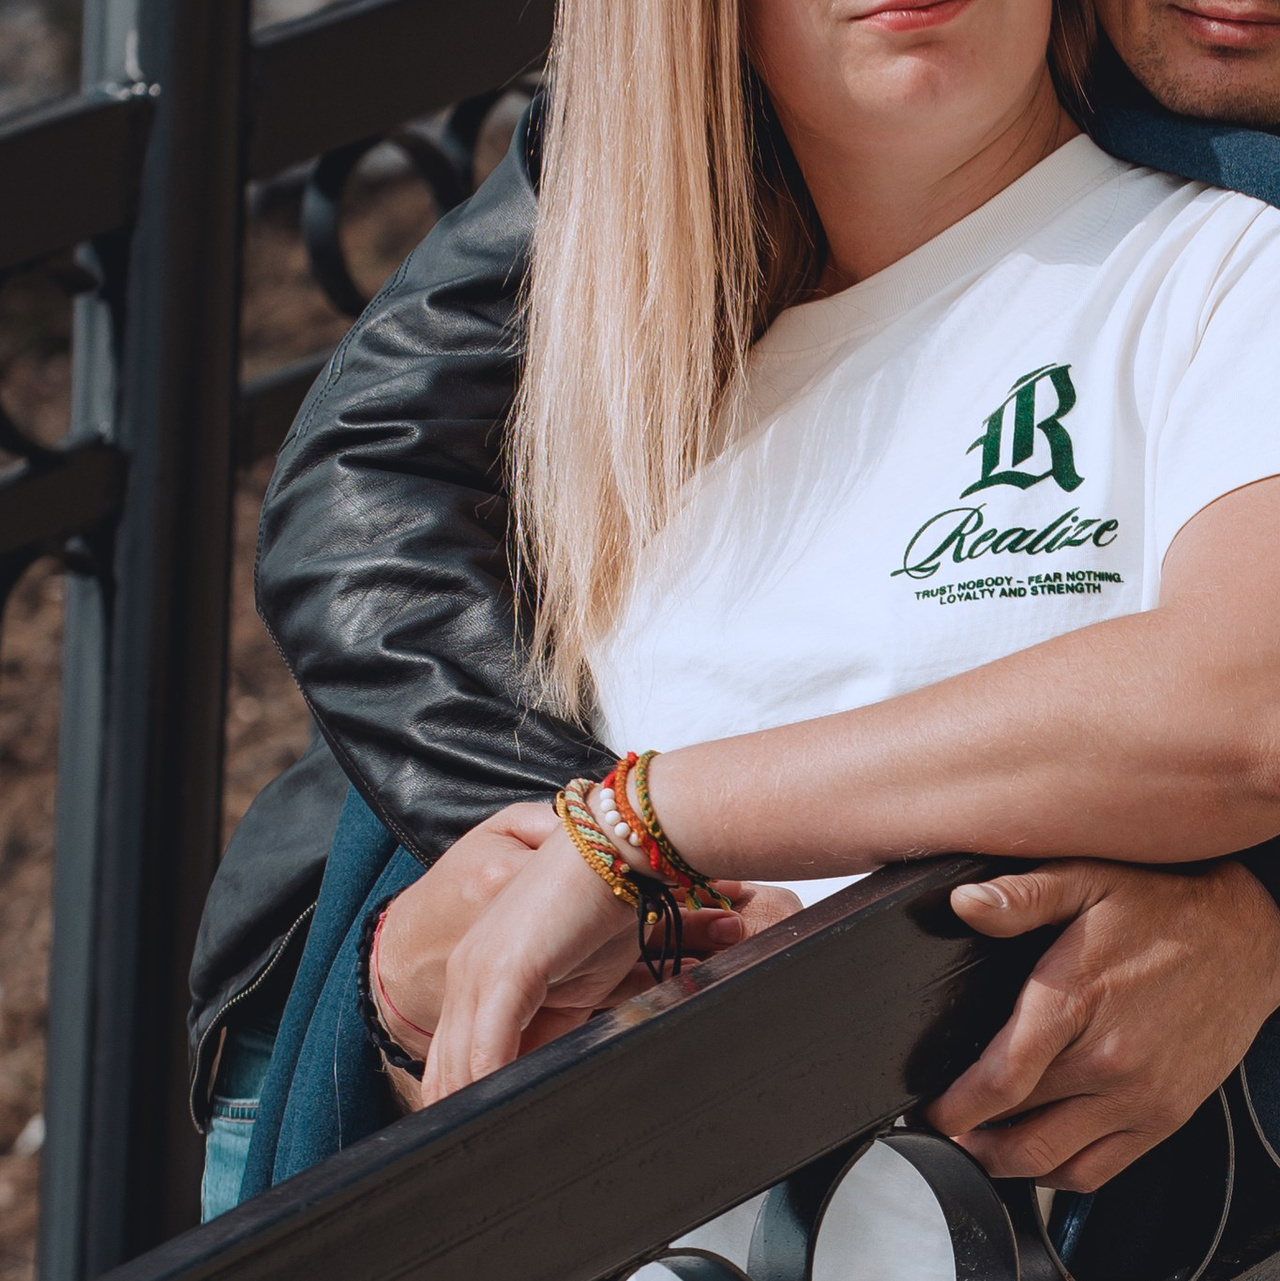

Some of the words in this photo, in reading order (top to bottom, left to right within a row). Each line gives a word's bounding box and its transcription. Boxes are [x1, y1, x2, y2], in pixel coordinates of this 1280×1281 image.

[960, 363, 1085, 499] R
[890, 503, 1119, 579] Realize
[915, 585, 954, 600] TRUST
[958, 577, 1012, 592] NOBODY
[1028, 572, 1062, 585] FEAR
[1066, 570, 1124, 583] NOTHING.
[940, 585, 996, 605] LOYALTY
[999, 586, 1027, 598] AND
[1030, 582, 1102, 597] STRENGTH
